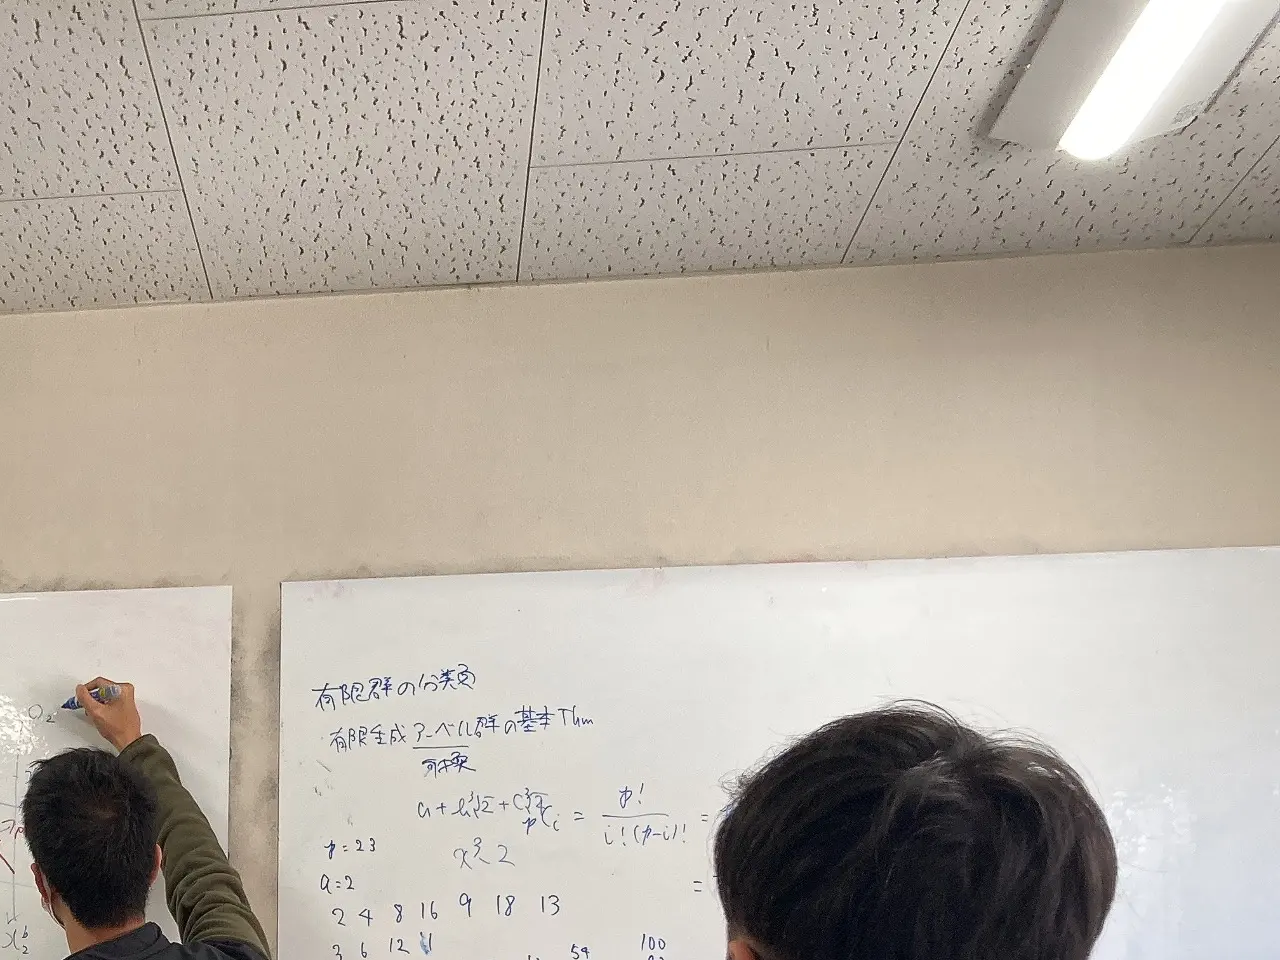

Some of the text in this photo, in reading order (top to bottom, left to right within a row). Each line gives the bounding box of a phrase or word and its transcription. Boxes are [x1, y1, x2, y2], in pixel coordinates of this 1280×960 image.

[332, 907, 346, 926] 2
[358, 908, 373, 926] 4
[421, 901, 438, 919] 16
[497, 895, 515, 916] 18
[541, 895, 560, 916] 13
[389, 938, 410, 954] 12
[641, 934, 666, 951] 100
